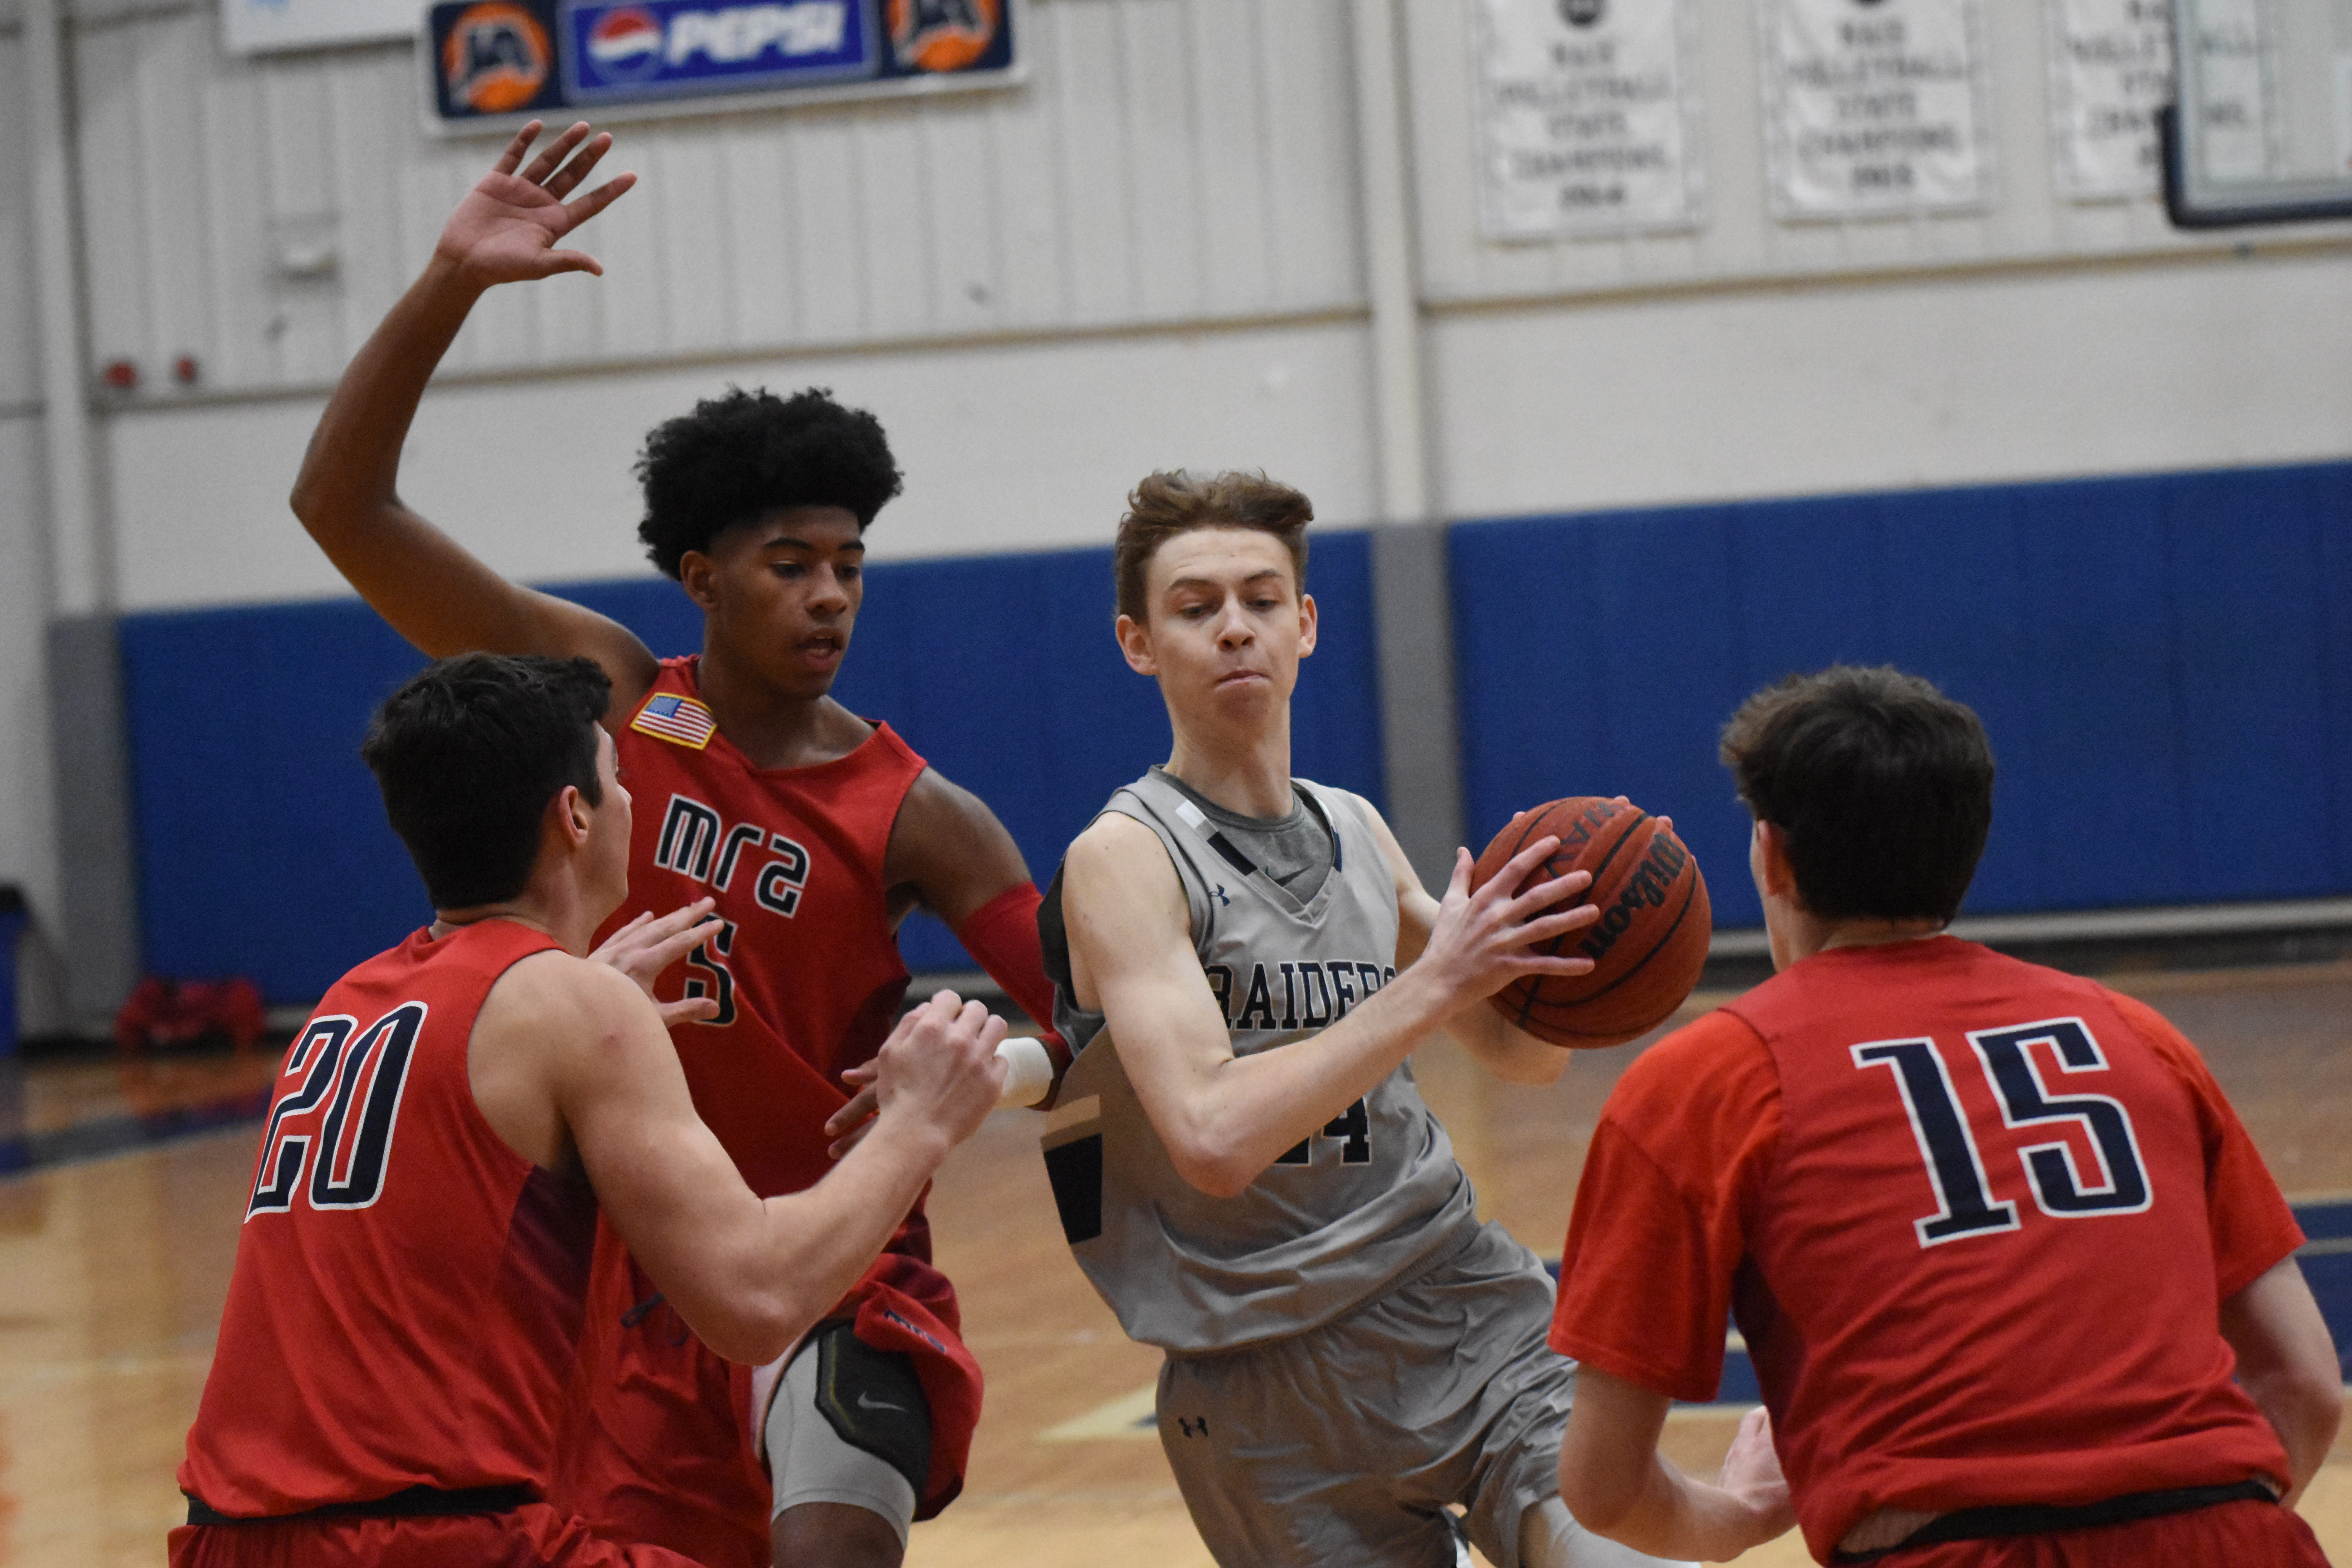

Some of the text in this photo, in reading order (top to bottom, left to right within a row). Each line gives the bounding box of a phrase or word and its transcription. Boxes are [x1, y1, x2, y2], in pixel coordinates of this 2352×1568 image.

[665, 2, 847, 65] PEPSI
[1577, 832, 1686, 959] Wilson
[683, 911, 739, 1027] 5
[243, 1000, 428, 1224] 20
[1273, 1095, 1372, 1167] 4
[1849, 1016, 2153, 1249] 15
